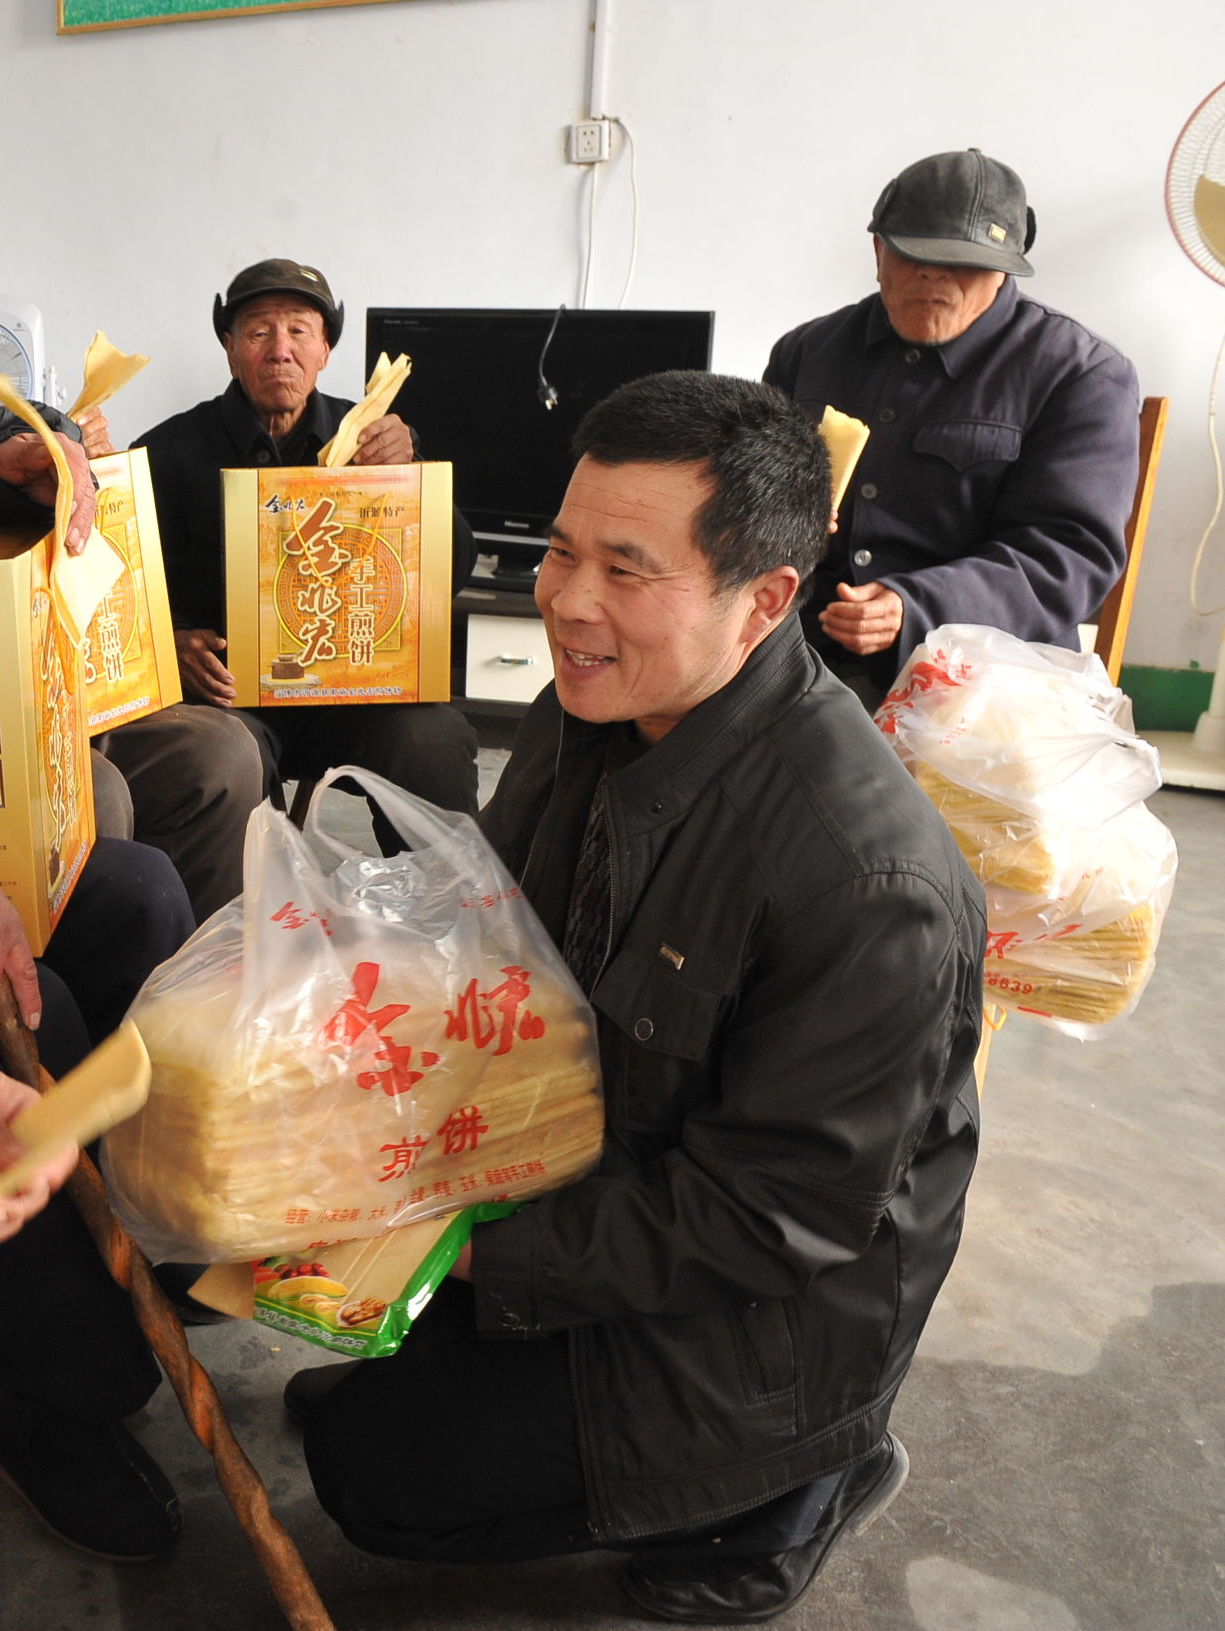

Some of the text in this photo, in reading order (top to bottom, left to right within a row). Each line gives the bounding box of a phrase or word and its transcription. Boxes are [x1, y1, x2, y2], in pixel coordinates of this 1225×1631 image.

[98, 590, 125, 682] 工煎饼
[347, 555, 376, 666] 手工煎饼
[983, 977, 1033, 995] 8639
